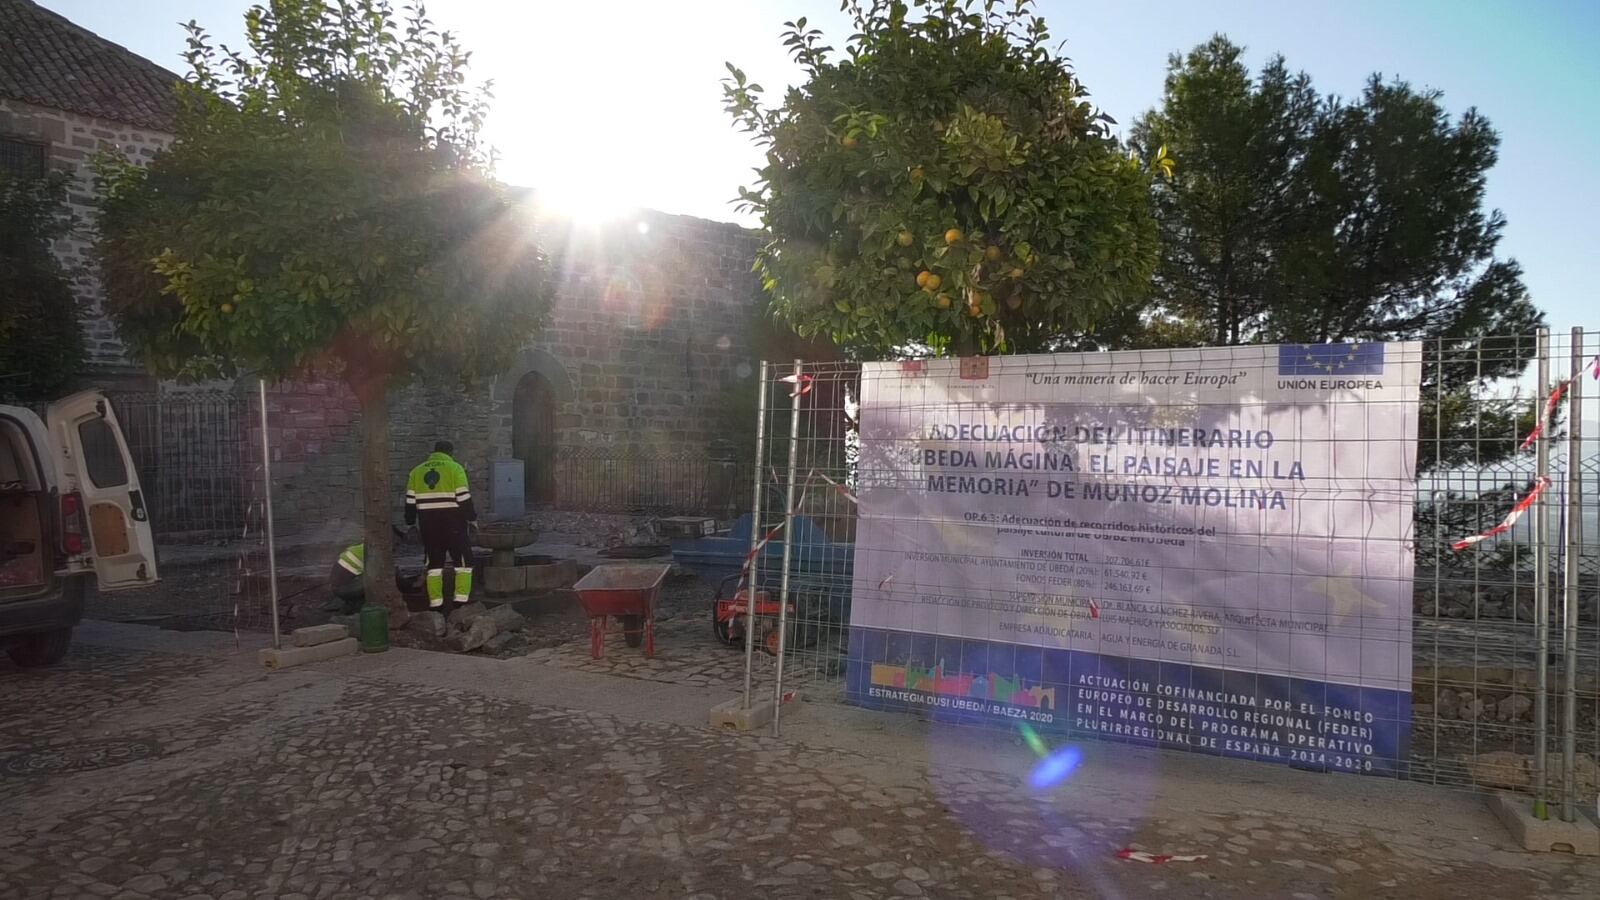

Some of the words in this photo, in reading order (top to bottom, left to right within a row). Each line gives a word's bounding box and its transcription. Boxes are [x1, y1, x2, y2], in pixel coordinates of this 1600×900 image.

[1064, 374, 1114, 386] manera
[1119, 371, 1136, 385] de
[1140, 371, 1179, 386] hacer
[1277, 379, 1317, 390] UNIÓN
[1320, 380, 1383, 390] EUROPEA
[929, 422, 1067, 443] ADECUACIÓN
[1075, 427, 1118, 445] DEL
[1127, 427, 1274, 449] ITINERARIO
[1090, 455, 1114, 473] EL
[1124, 456, 1221, 477] PAISAJE
[1230, 459, 1263, 479] EN
[1274, 461, 1306, 480] LA
[1047, 480, 1075, 499] DE
[1083, 480, 1172, 504] MUÑOZ
[1181, 488, 1287, 510] MOLINA
[1063, 518, 1076, 528] de
[1080, 521, 1136, 532] recorridos
[1197, 526, 1216, 537] del
[1036, 562, 1048, 572] DE
[1064, 552, 1089, 562] TOTAL
[1016, 573, 1046, 585] FONDOS
[1048, 576, 1072, 587] FEDER
[999, 623, 1032, 633] EMPRESA
[1101, 633, 1123, 644] AGUA
[1167, 641, 1178, 651] DE
[869, 687, 925, 705] ESTRATEGIA
[926, 696, 950, 708] DUSI
[992, 704, 1028, 720] BAEZA
[1029, 711, 1053, 724] 2020
[1079, 674, 1150, 692] ACTUACIÓN
[1156, 684, 1256, 707] COFINANCIADA
[1264, 698, 1293, 712] POR
[1300, 703, 1316, 715] EL
[1324, 706, 1374, 724] FONDO
[1078, 688, 1132, 705] EUROPEO
[1137, 696, 1152, 708] DE
[1157, 699, 1238, 720] DESARROLLO
[1244, 711, 1312, 731] REGIONAL
[1318, 720, 1374, 741] (FEDER)
[1077, 703, 1093, 715] EN
[1099, 706, 1113, 718] EL
[1119, 709, 1164, 725] MARCO
[1170, 716, 1195, 730] DEL
[1201, 720, 1280, 742] PROGRAMA
[1288, 733, 1373, 756] OPERATIVO
[1076, 718, 1191, 745] PLURIRREGIONAL
[1200, 736, 1217, 748] DE
[1225, 739, 1281, 758] ESPAÑA
[1290, 749, 1373, 772] 2014-2020
